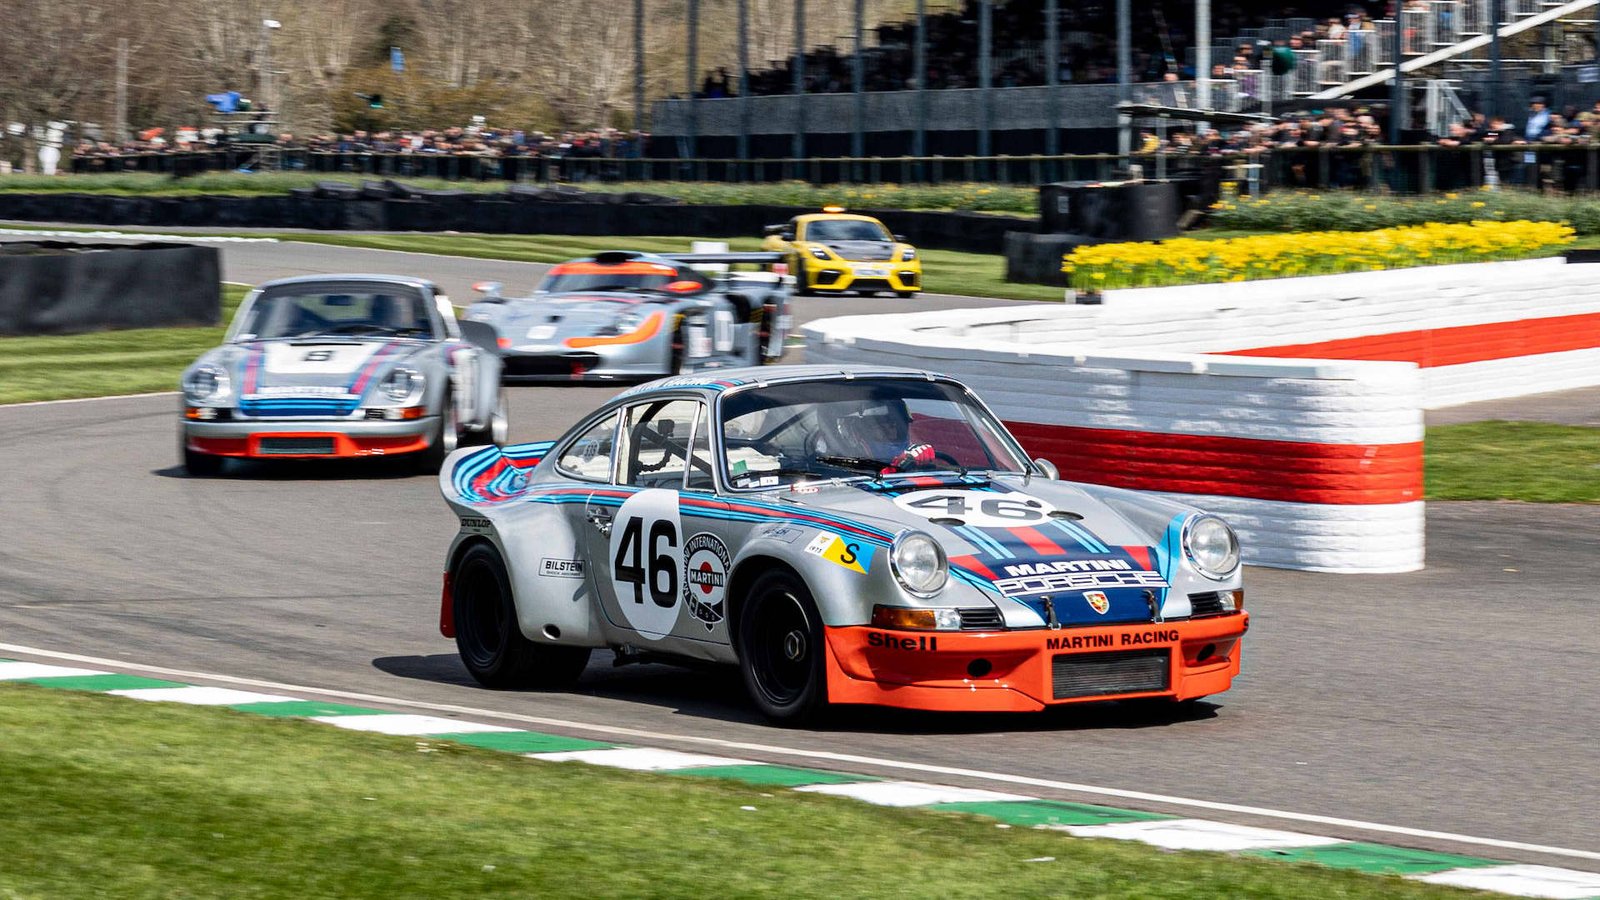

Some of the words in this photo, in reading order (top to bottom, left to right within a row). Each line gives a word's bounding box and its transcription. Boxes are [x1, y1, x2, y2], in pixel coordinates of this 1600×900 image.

[907, 494, 1043, 520] 46
[460, 518, 491, 528] DUNLOP
[614, 516, 678, 608] 46
[841, 543, 860, 564] S
[545, 560, 583, 572] BILSTEIN
[1004, 559, 1132, 577] MARTINI
[690, 570, 723, 586] MARTINI
[992, 571, 1172, 599] PORSCHE
[868, 632, 937, 651] Shell
[1046, 634, 1113, 650] MARTINI
[1121, 630, 1180, 646] RACING
